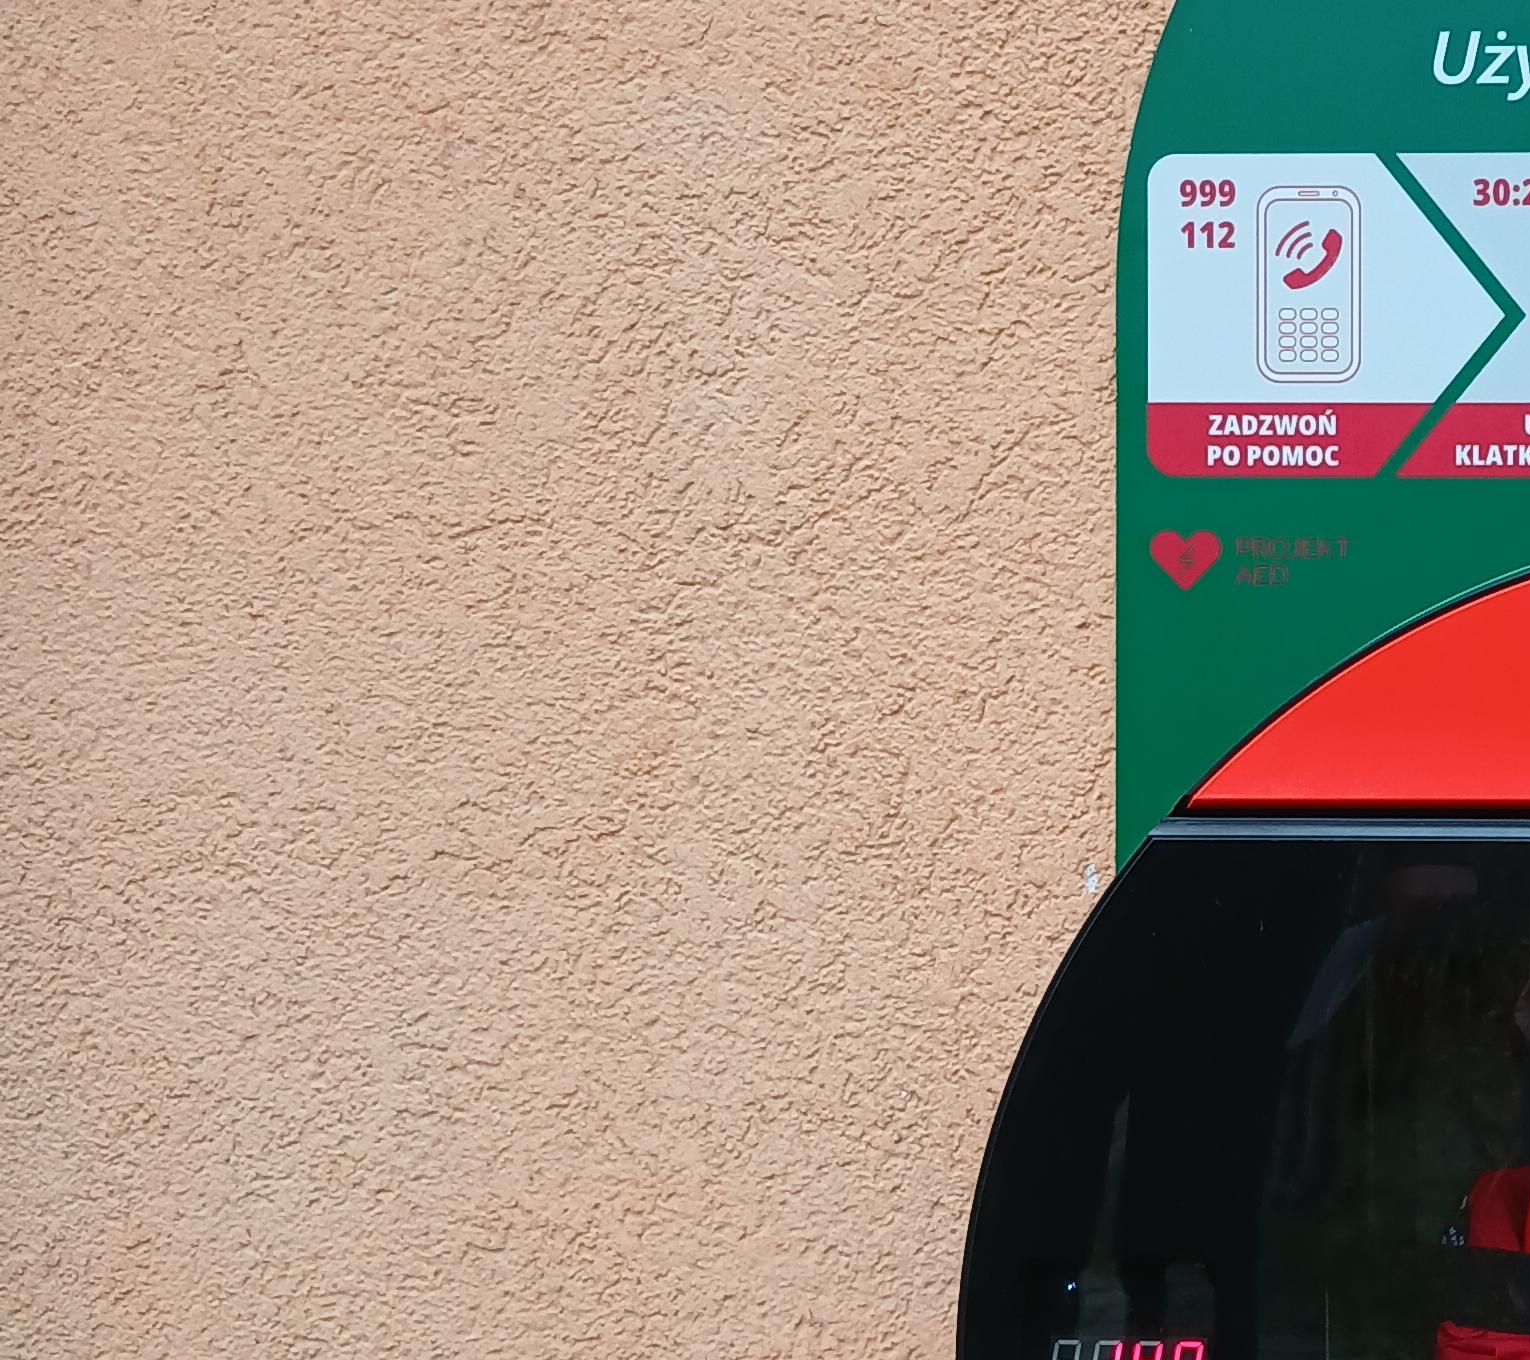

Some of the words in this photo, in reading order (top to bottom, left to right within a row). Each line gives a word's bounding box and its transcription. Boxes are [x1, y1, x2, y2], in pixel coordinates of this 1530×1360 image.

[1179, 179, 1236, 208] 999
[1180, 221, 1236, 249] 112
[1207, 408, 1338, 437] ZADZWOŃ
[1206, 445, 1243, 467] PO
[1247, 444, 1340, 467] POMOC
[1235, 536, 1350, 559] PROJEKT
[1236, 563, 1288, 586] AED
